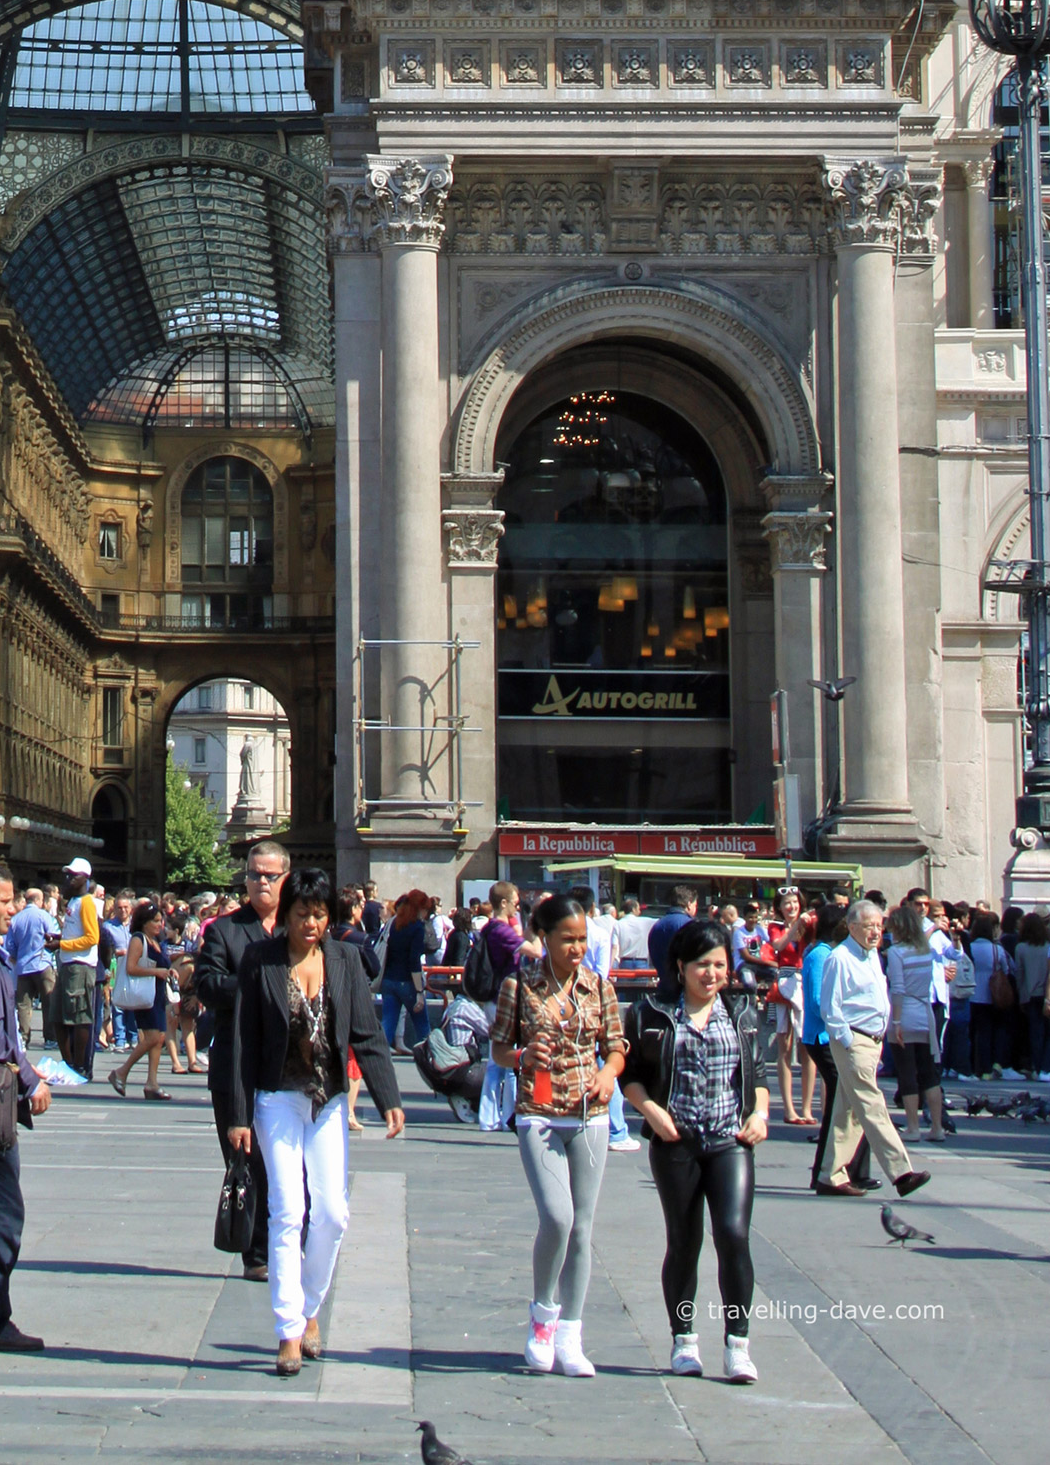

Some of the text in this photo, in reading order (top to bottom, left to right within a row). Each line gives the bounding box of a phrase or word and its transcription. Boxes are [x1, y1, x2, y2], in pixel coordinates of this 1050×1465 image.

[576, 692, 697, 709] AUTOGRILL
[523, 835, 615, 853] la Repubblica
[664, 836, 756, 852] la Repubblica
